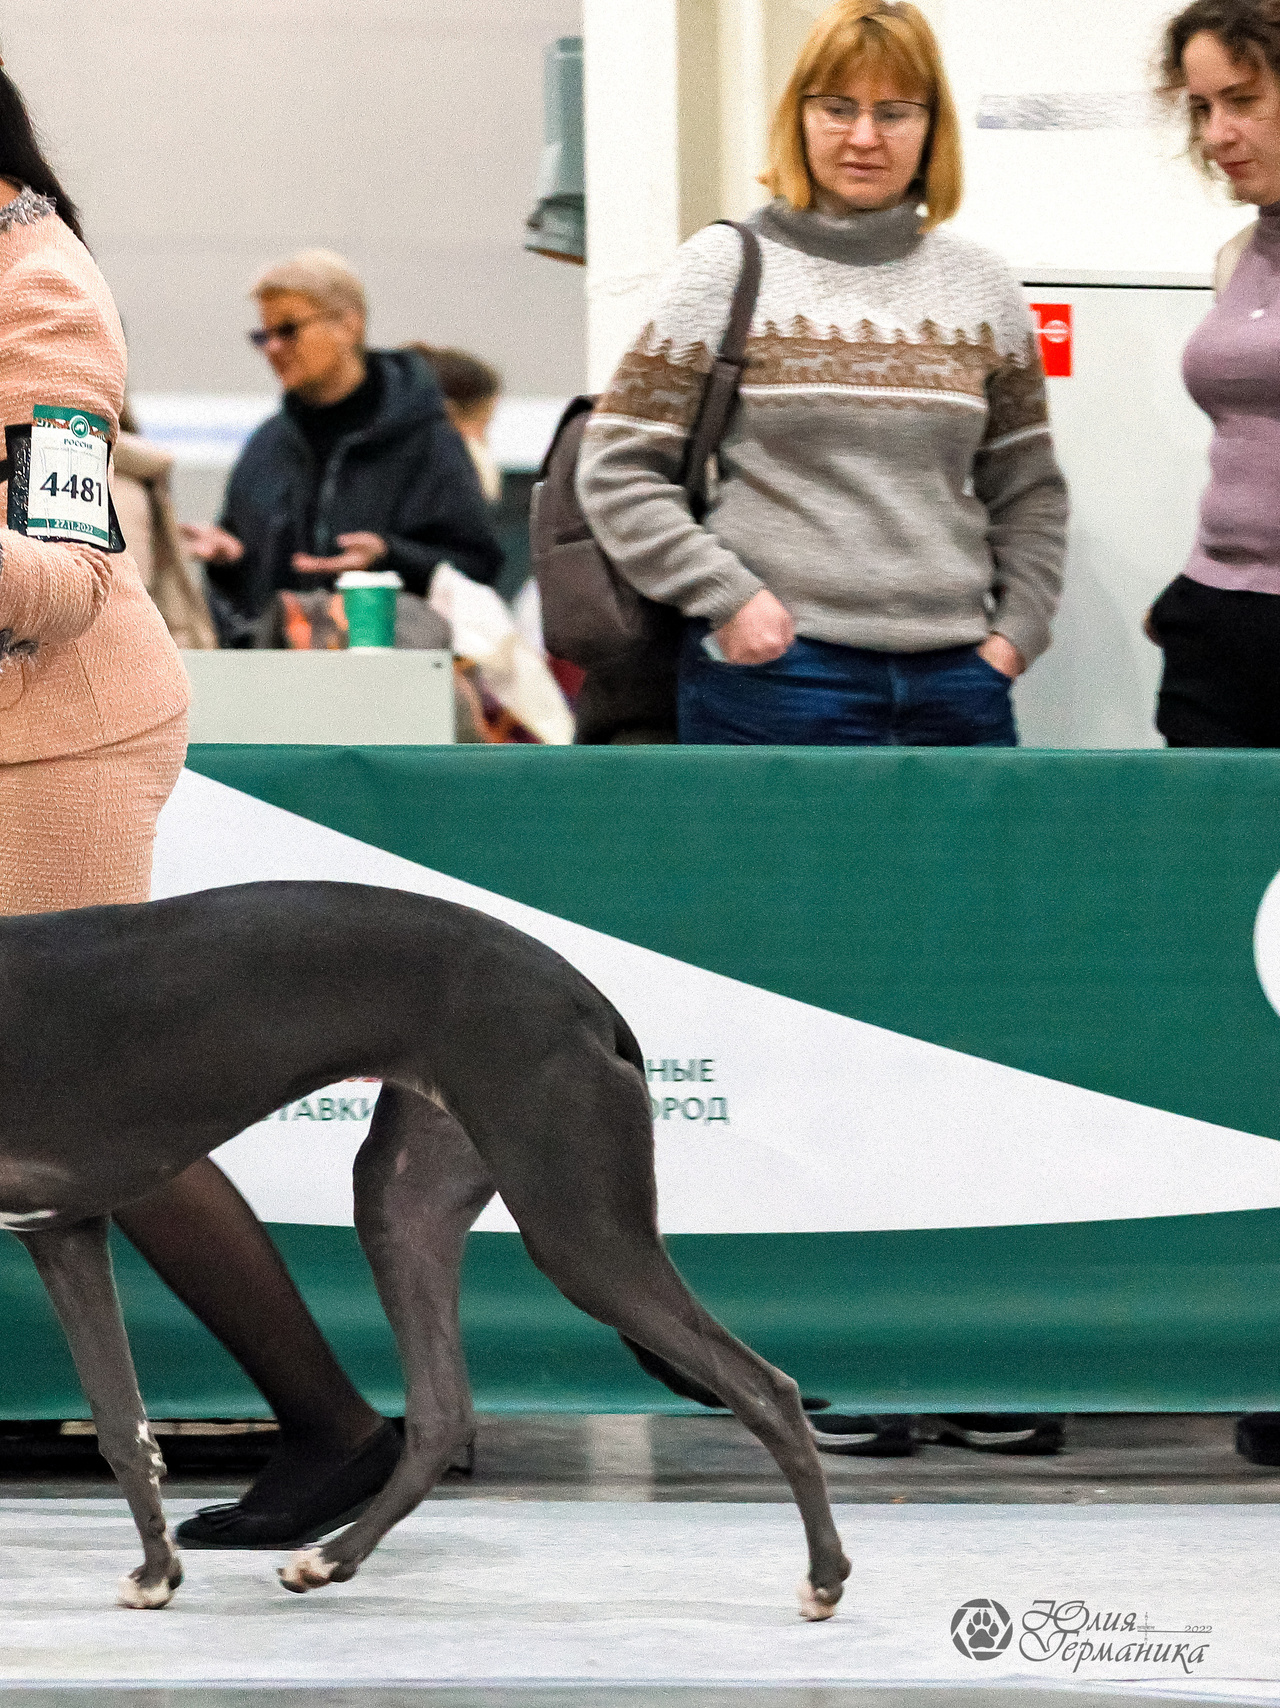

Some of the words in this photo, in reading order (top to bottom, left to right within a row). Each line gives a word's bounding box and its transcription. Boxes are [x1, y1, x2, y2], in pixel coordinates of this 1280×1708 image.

[63, 438, 93, 450] РОССИЯ
[40, 471, 102, 509] 4481
[54, 519, 94, 534] 27.11.2022
